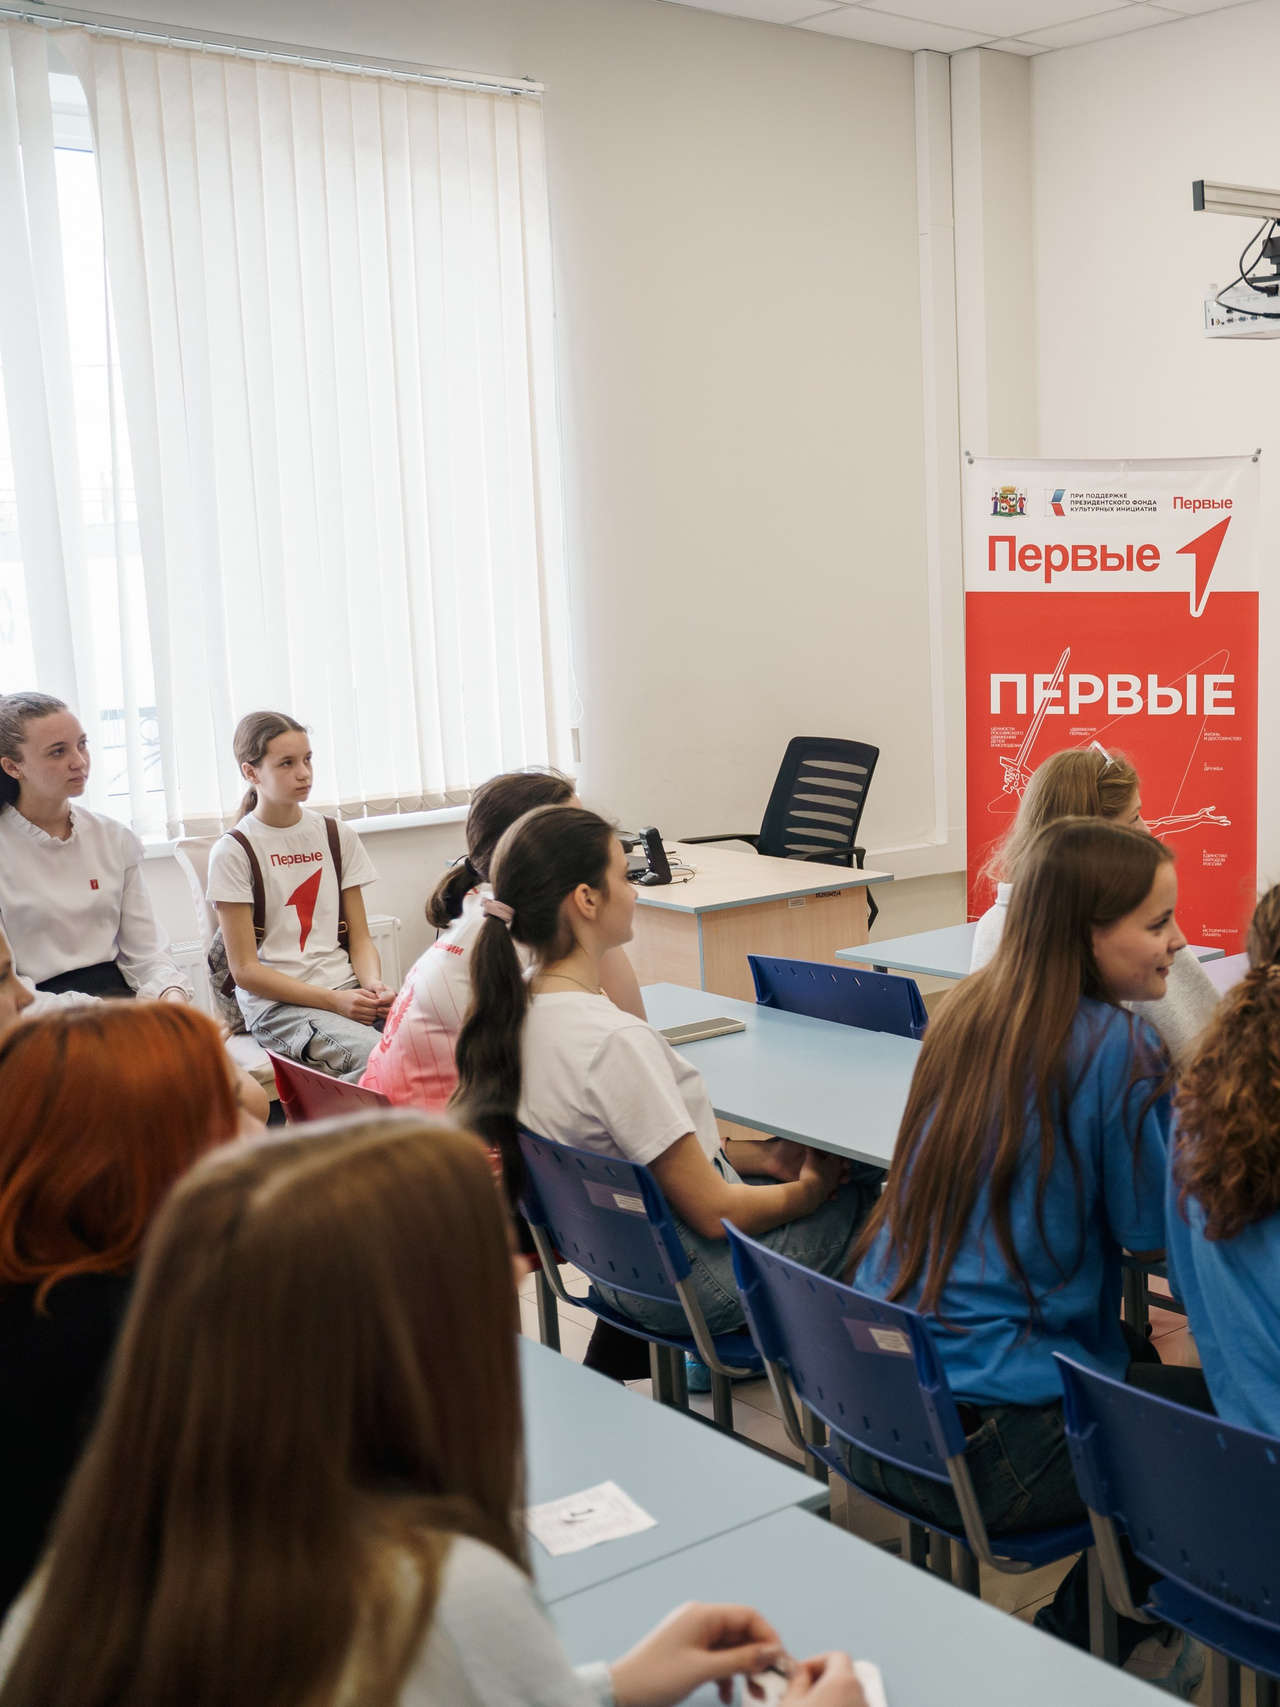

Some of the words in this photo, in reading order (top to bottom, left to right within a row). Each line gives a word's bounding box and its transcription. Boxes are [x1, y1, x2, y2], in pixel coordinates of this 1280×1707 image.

[1172, 496, 1233, 513] Первые
[988, 535, 1161, 583] Первые
[990, 673, 1235, 715] ПЕРВЫЕ
[270, 851, 323, 868] Первые
